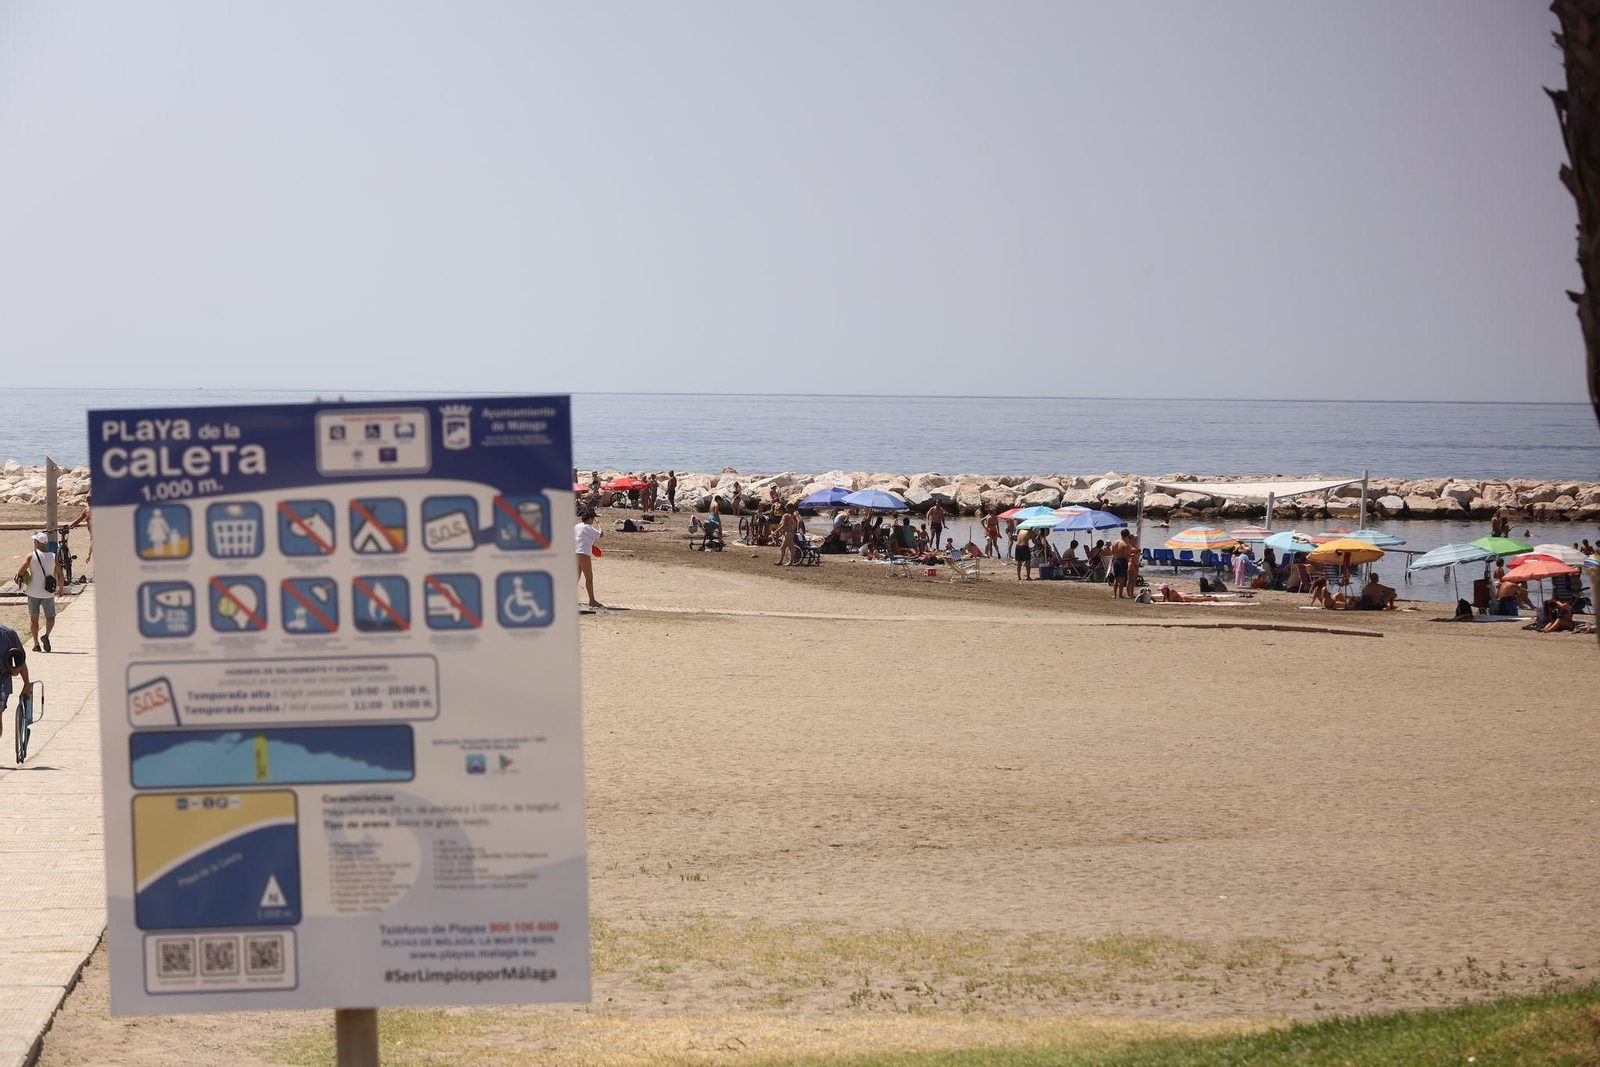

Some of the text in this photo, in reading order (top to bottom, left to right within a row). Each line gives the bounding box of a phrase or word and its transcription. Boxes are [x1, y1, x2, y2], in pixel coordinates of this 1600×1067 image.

[482, 406, 556, 419] Ayuntamiento
[198, 423, 221, 440] de
[224, 422, 241, 439] la
[491, 421, 506, 432] de
[141, 478, 223, 501] 1.000 m.
[429, 520, 467, 545] S.O.S.
[132, 686, 170, 716] S.O.S.
[187, 690, 247, 702] Temporada
[251, 689, 271, 699] alta
[185, 705, 244, 717] Temporada
[247, 703, 280, 713] media
[268, 892, 279, 903] N
[431, 923, 447, 934] de
[449, 922, 487, 936] Playas
[384, 966, 558, 983] #SerLimpiosporMálaga
